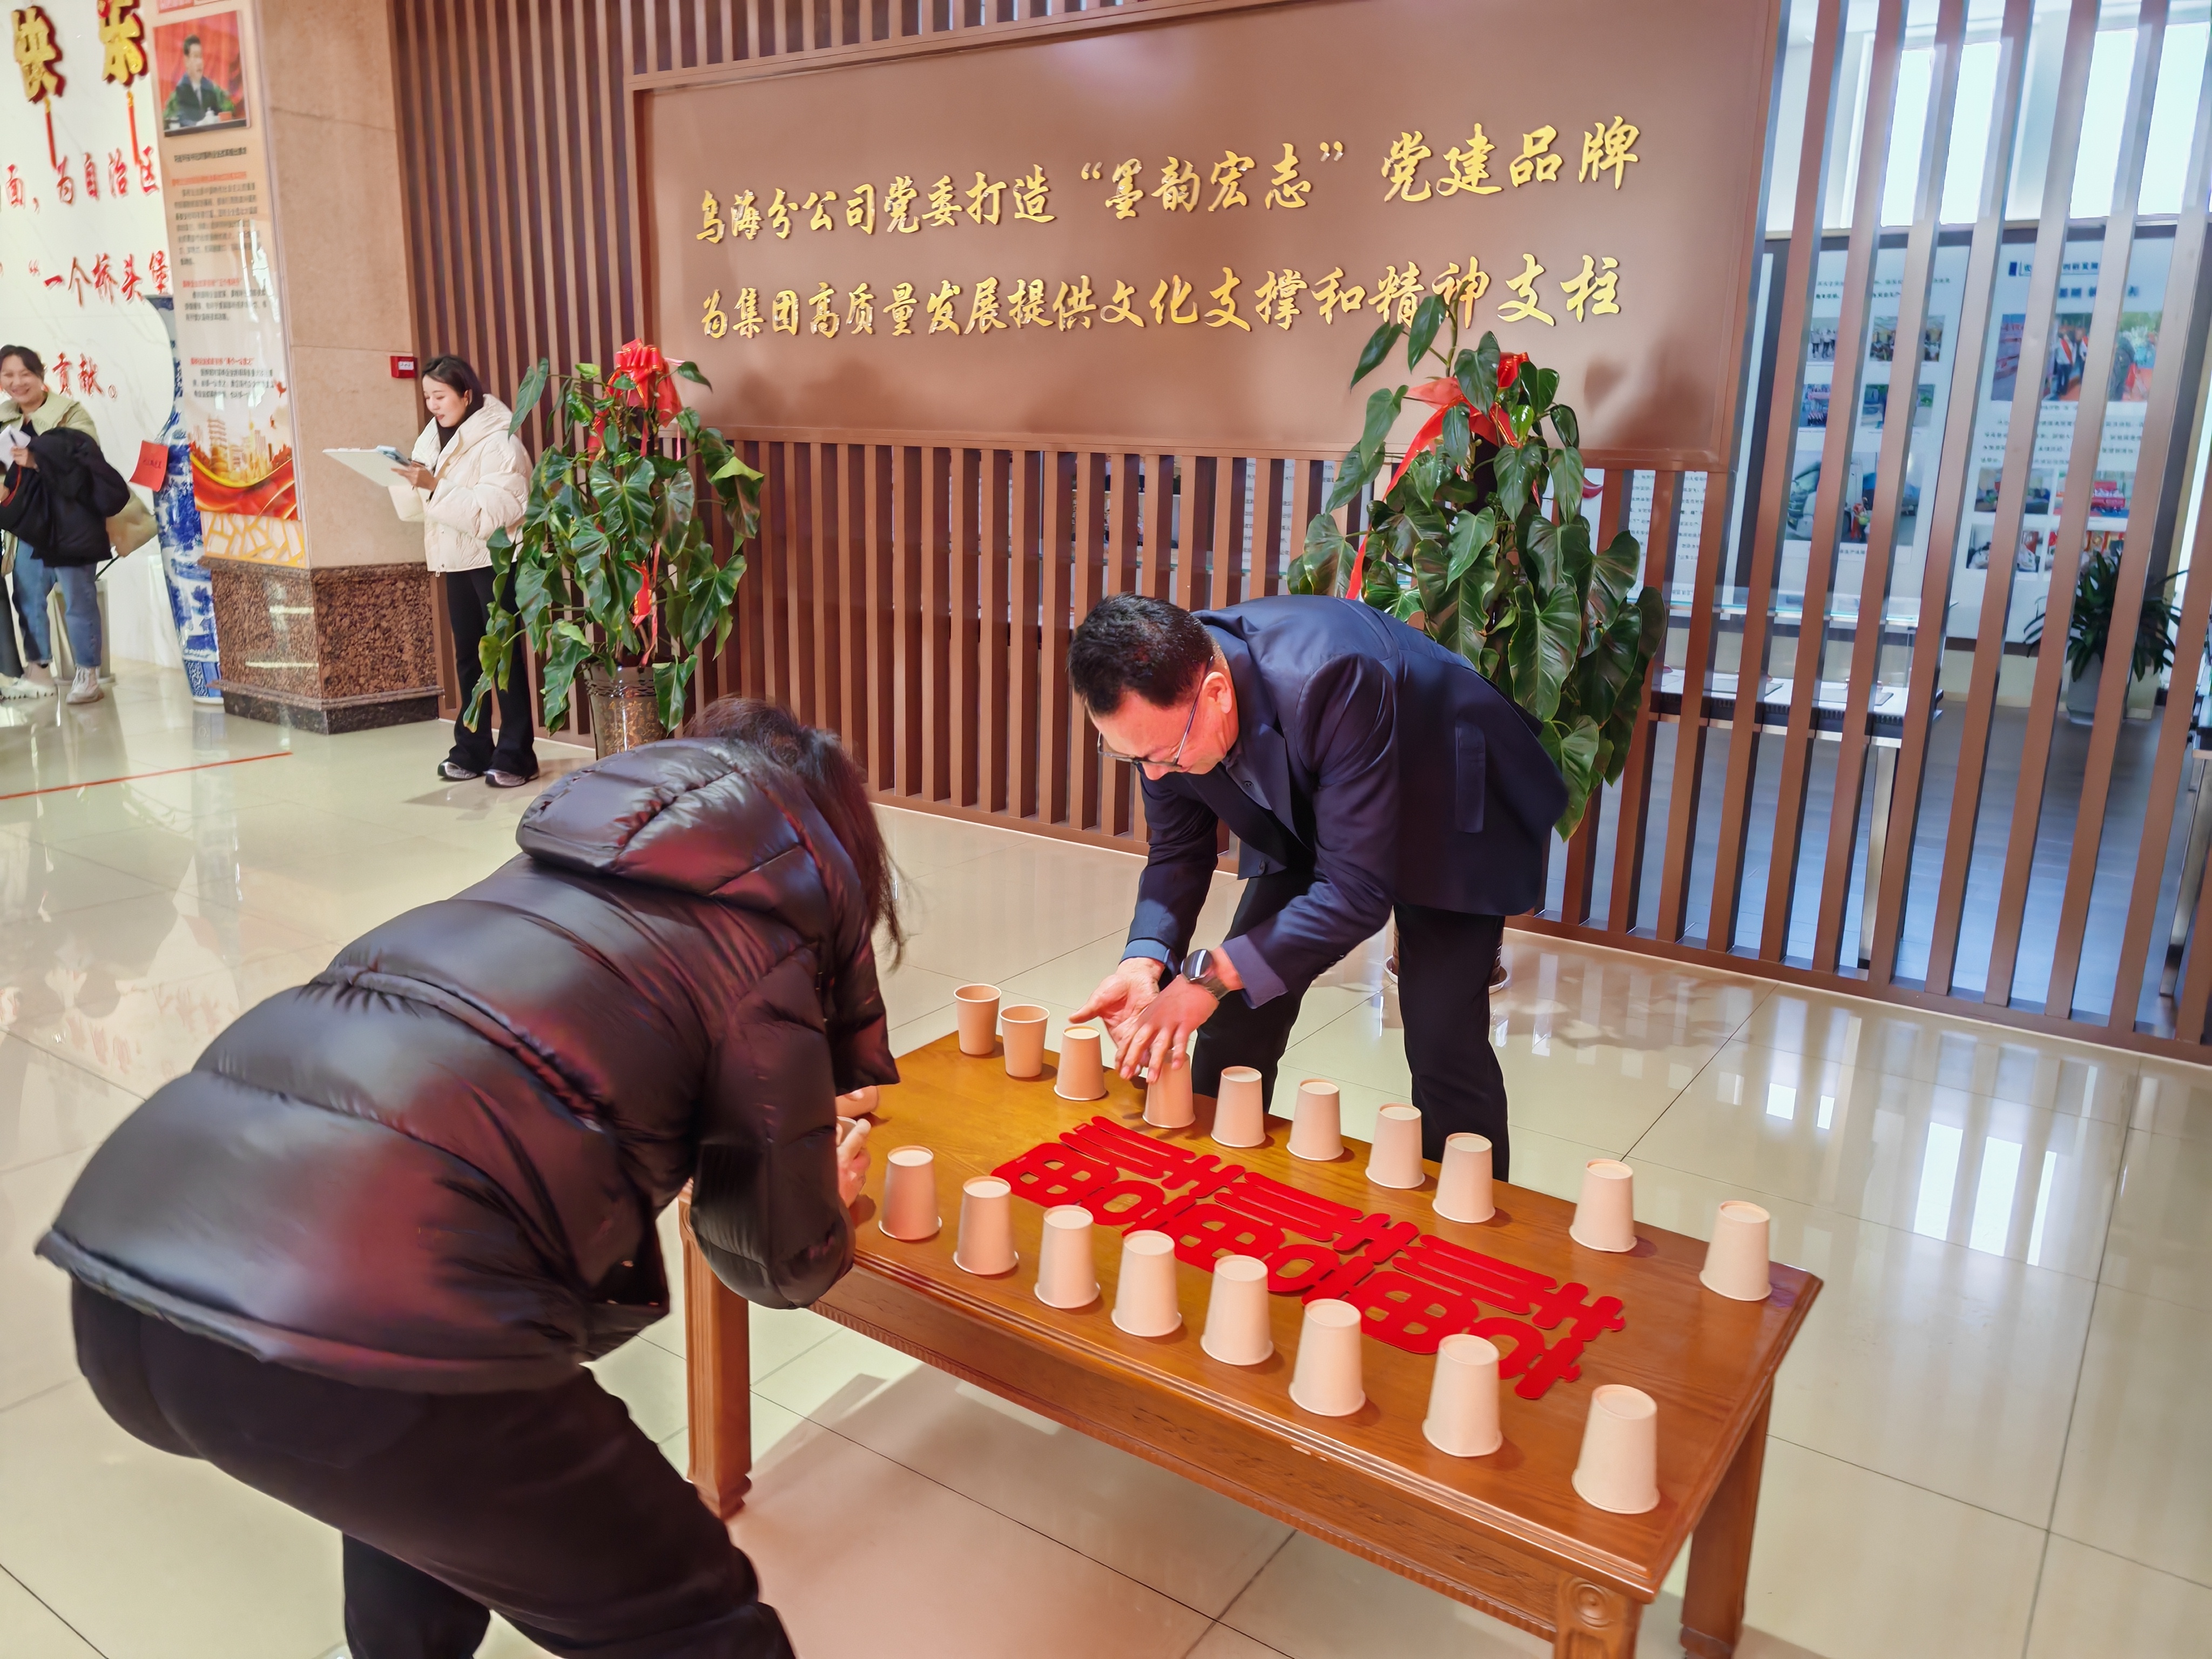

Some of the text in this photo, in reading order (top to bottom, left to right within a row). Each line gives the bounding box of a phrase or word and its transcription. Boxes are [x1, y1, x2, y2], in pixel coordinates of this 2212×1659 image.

[701, 253, 1621, 338] 为集团高质量发展提供文化支撑和精神支柱
